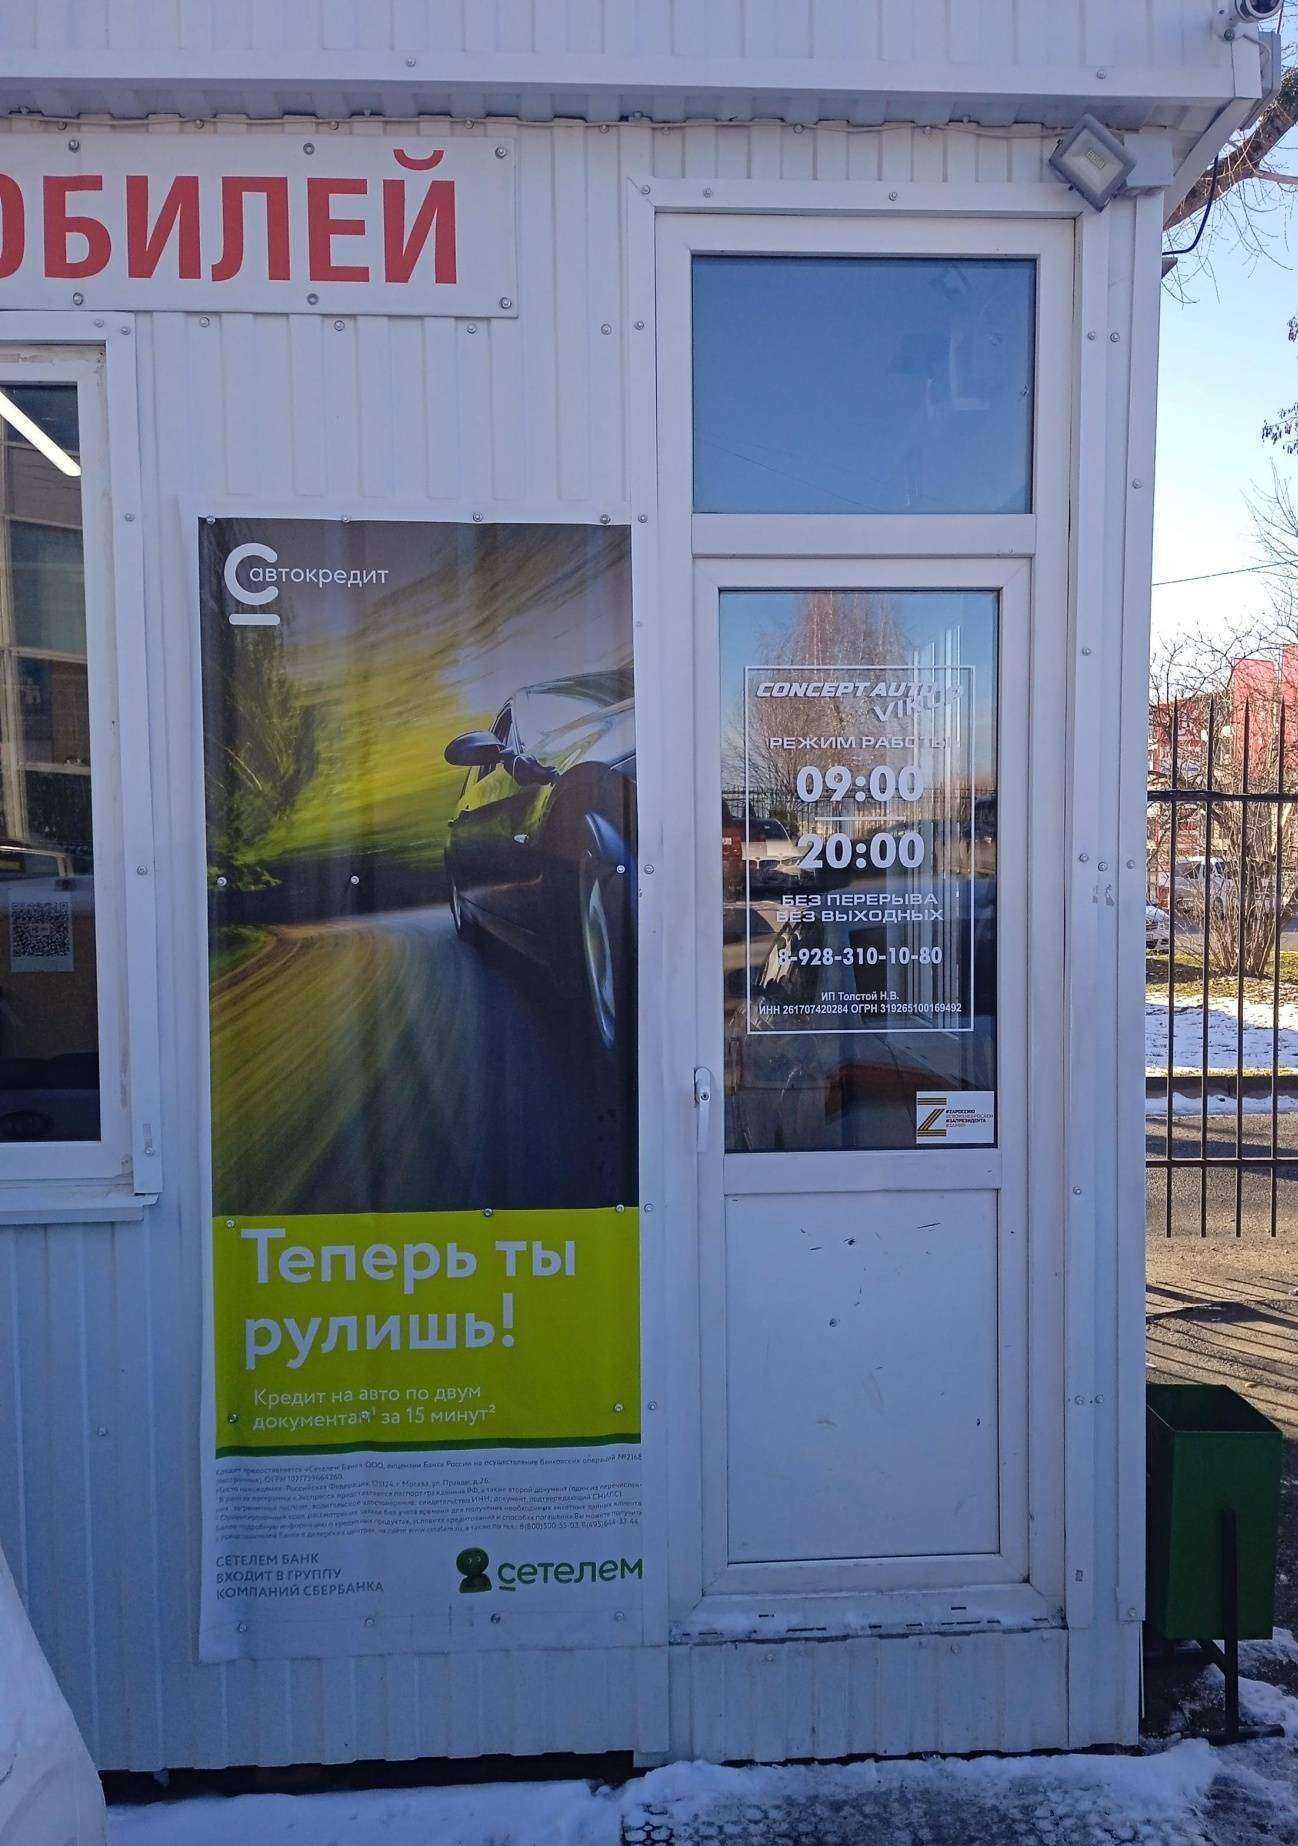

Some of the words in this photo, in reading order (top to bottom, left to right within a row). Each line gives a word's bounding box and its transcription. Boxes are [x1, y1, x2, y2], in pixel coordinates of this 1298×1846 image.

[250, 567, 389, 588] автокредит
[769, 736, 856, 749] РЕЖИМ
[796, 765, 924, 802] 09:00
[797, 832, 925, 869] 20:00
[782, 895, 821, 906] БЕЗ
[827, 893, 938, 906] ПЕРЕРЫВА
[821, 909, 944, 923] ВЫХОДНЫХ
[778, 946, 943, 966] 8-928-310-10-80
[821, 992, 836, 1001] ИП
[838, 991, 878, 1001] Толстой
[880, 991, 900, 1001] Н.В.
[759, 1004, 780, 1014] ИНН
[783, 1004, 848, 1015] 261707420284
[851, 1004, 878, 1013] ОГРН
[241, 1228, 478, 1295] Теперь
[496, 1240, 576, 1277] ты
[244, 1292, 516, 1370] рулишь!
[254, 1389, 326, 1408] Кредит
[332, 1390, 353, 1403] на
[359, 1386, 400, 1401] авто
[406, 1388, 429, 1400] по
[434, 1385, 481, 1403] двум
[381, 1412, 400, 1425] за
[407, 1408, 425, 1424] 15
[216, 1555, 278, 1567] СЕТЕЛЕМ
[282, 1552, 319, 1565] БАНК
[217, 1571, 271, 1584] ВХОДИТ
[275, 1571, 282, 1581] В
[287, 1569, 342, 1580] ГРУППУ
[498, 1558, 643, 1585] сетелем
[217, 1584, 300, 1599] КОМПАНИЙ
[303, 1582, 384, 1596] СБЕРБАНКА
